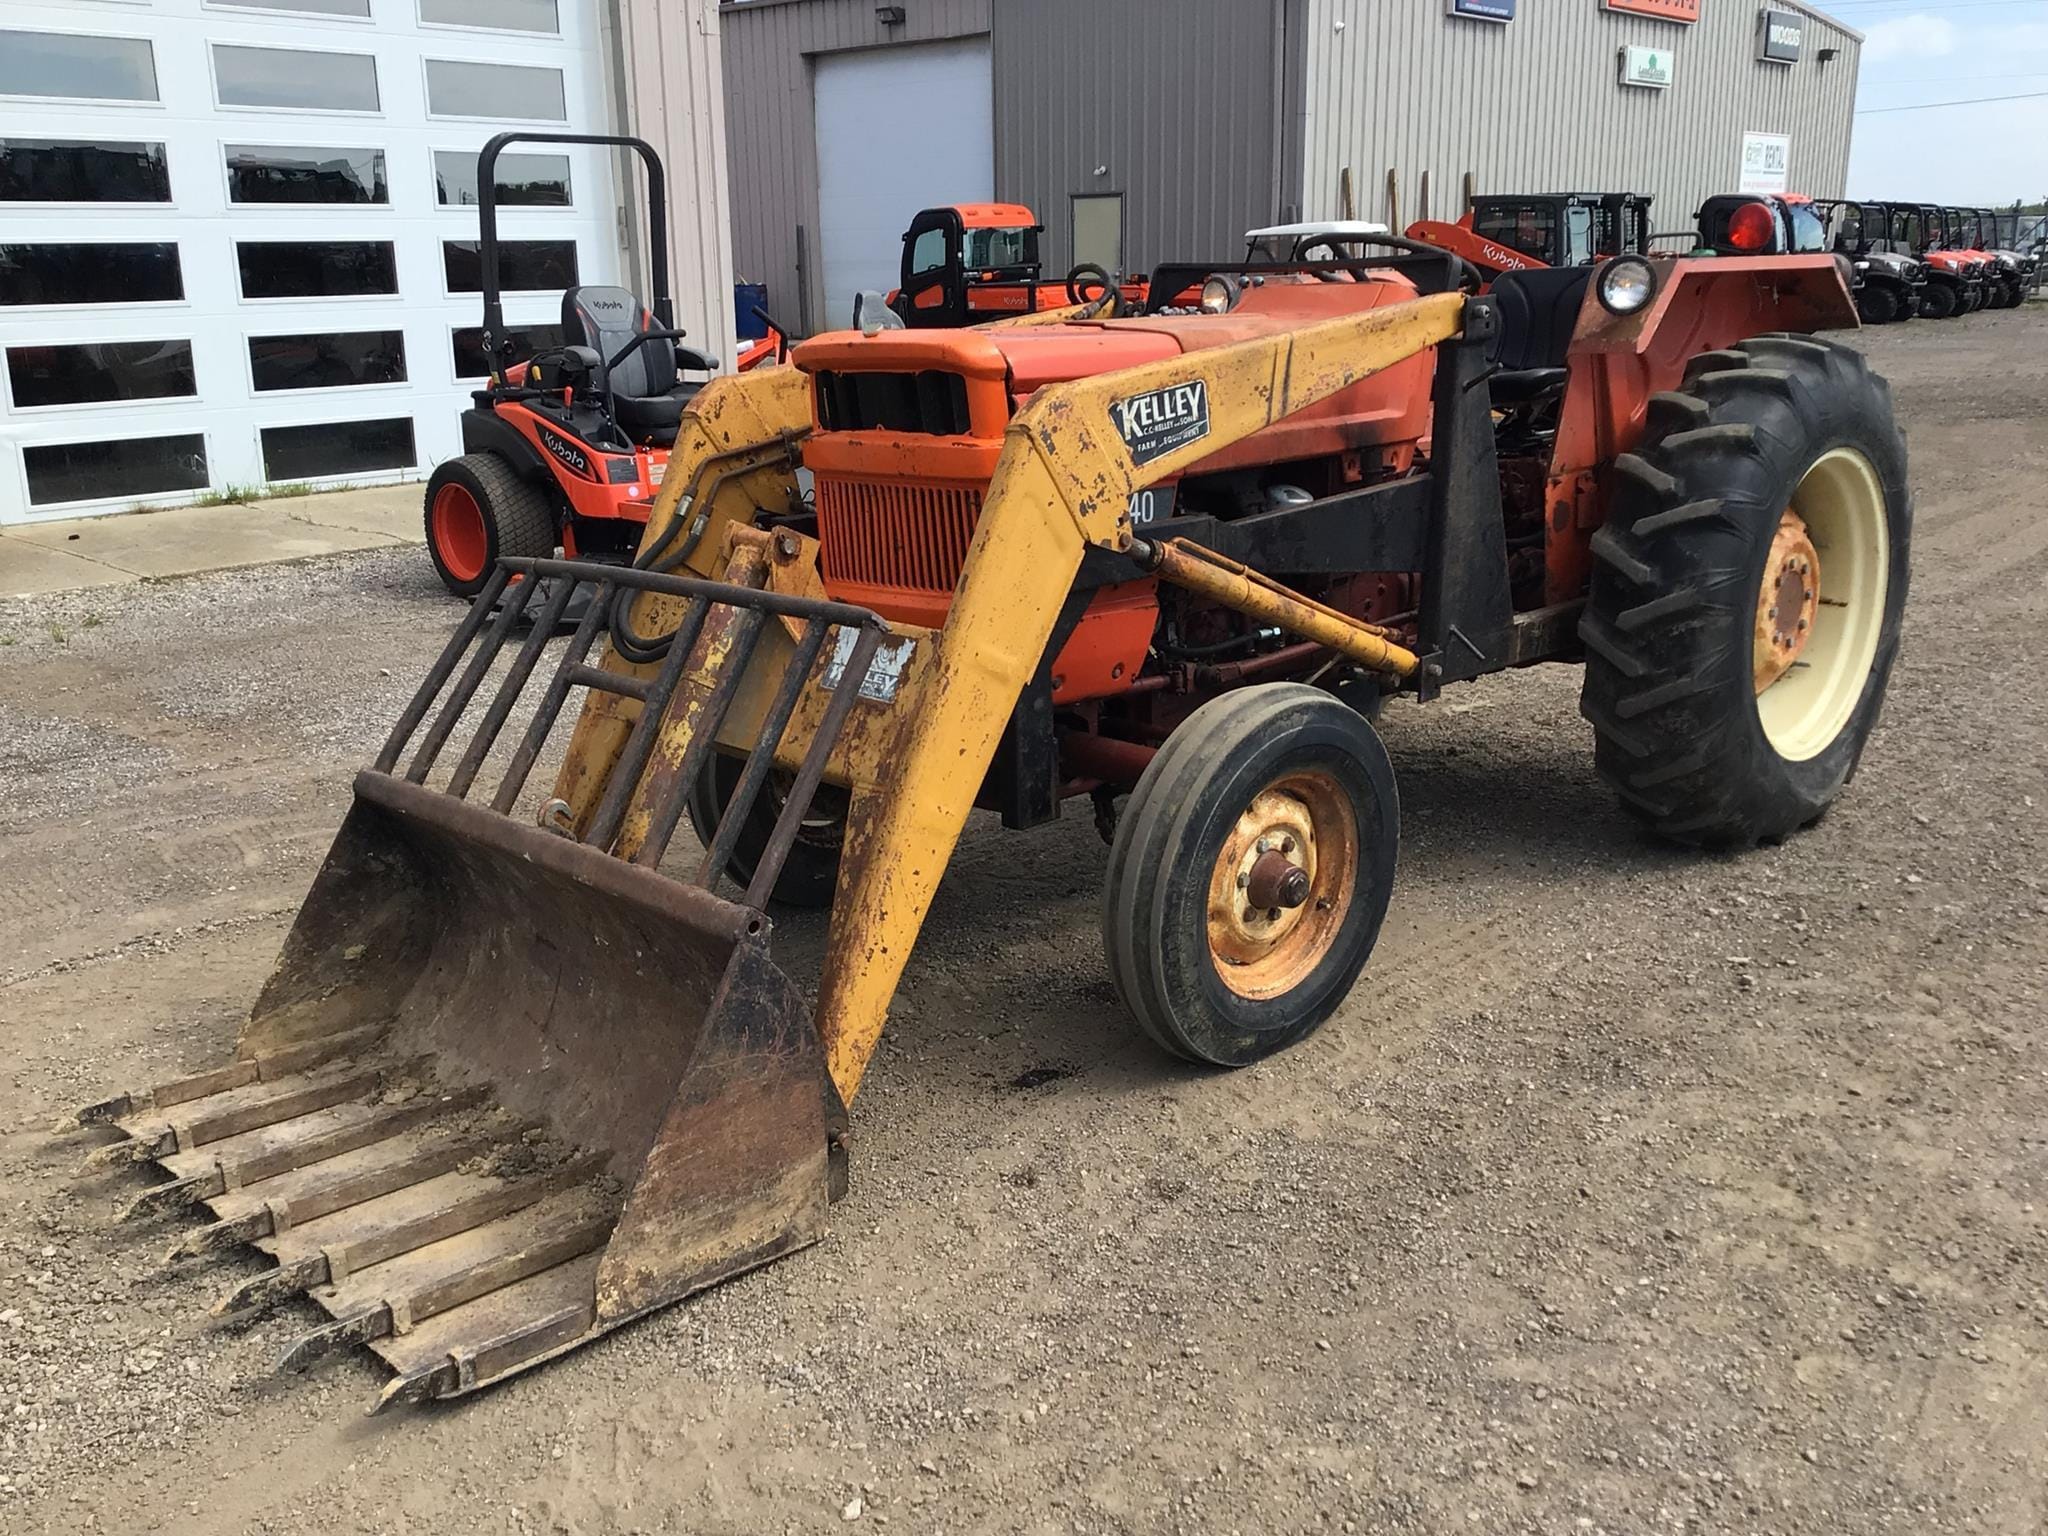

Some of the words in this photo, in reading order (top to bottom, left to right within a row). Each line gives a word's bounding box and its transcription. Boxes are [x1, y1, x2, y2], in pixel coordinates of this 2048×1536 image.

[1770, 24, 1801, 47] WOODS
[1483, 244, 1526, 271] Kubota
[593, 301, 623, 310] Kubota
[1117, 383, 1202, 441] KELLEY
[545, 431, 584, 469] Kubota
[1137, 440, 1156, 452] FARM
